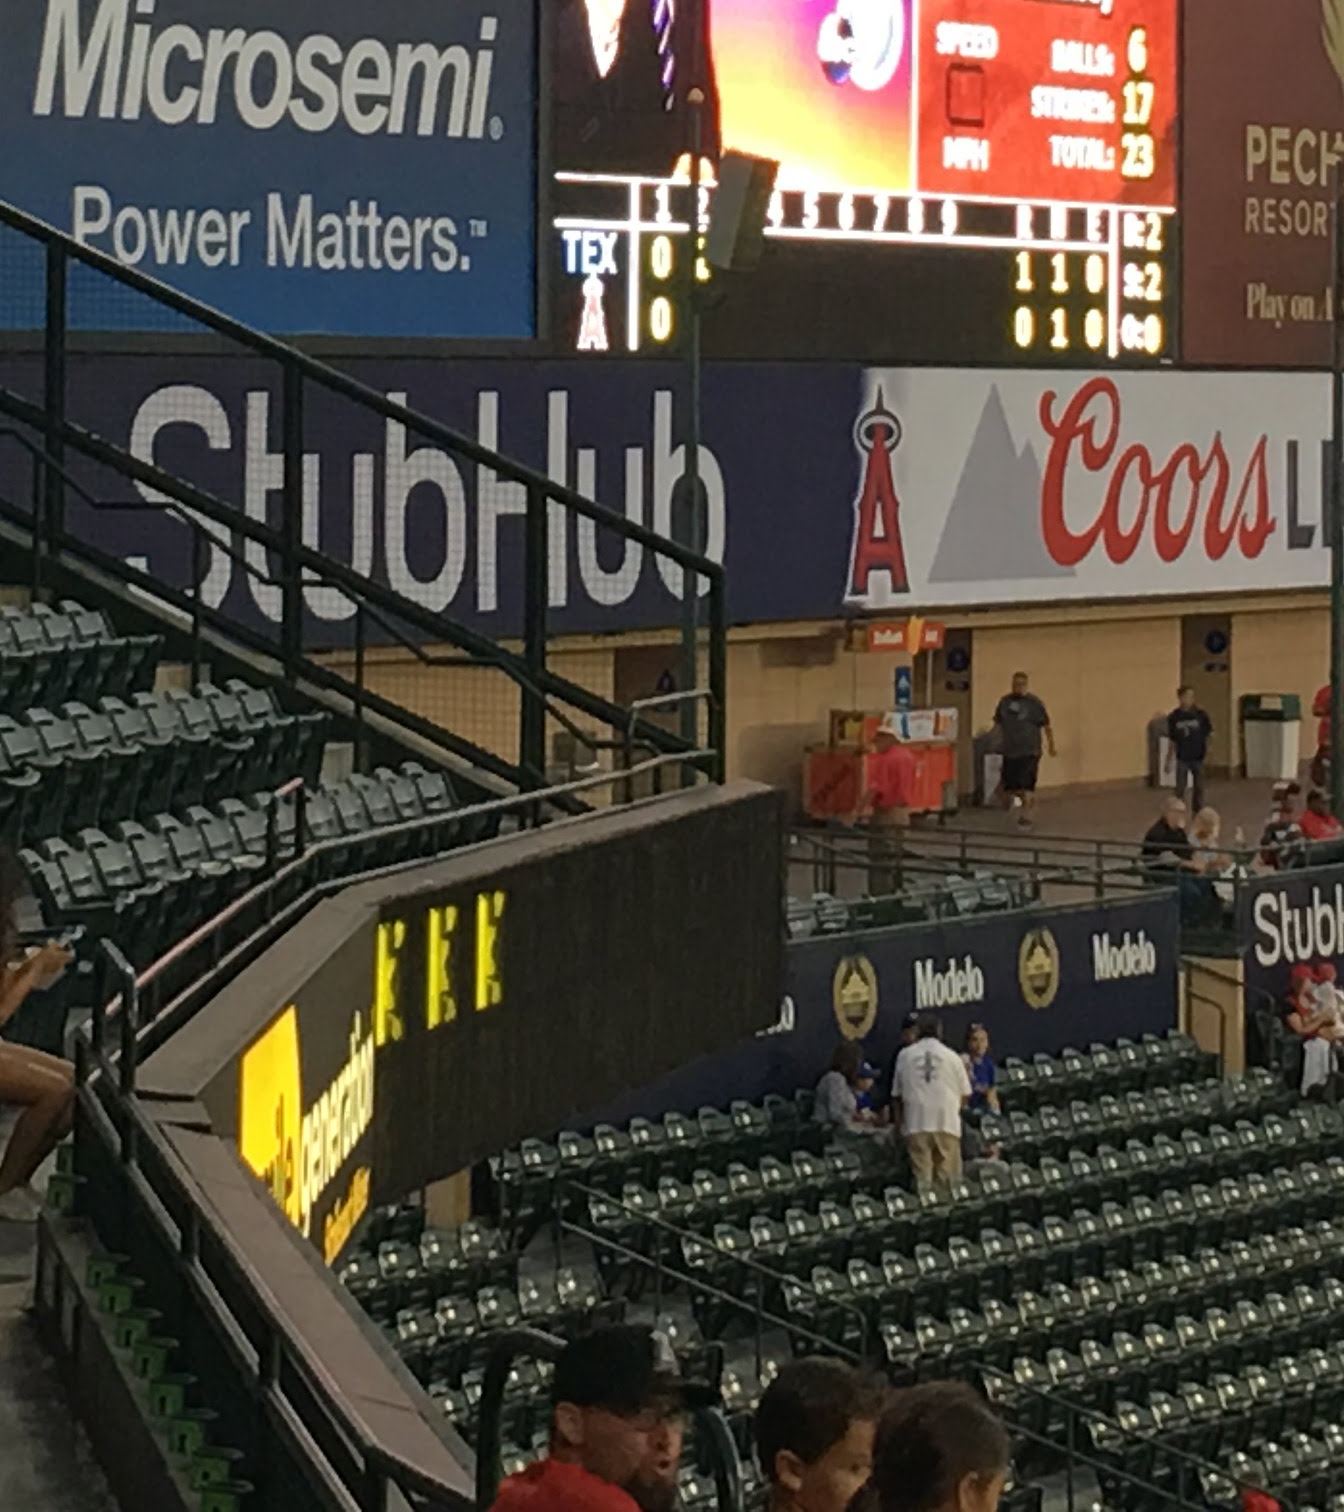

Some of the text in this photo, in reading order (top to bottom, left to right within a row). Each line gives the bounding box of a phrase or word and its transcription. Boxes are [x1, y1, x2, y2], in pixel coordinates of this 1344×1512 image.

[935, 21, 999, 59] SPEED
[1126, 28, 1147, 73] 6
[1121, 81, 1155, 125] 17
[943, 136, 990, 171] MPH
[1048, 133, 1154, 178] TOTAL: 23
[72, 185, 251, 266] Power
[1245, 197, 1336, 238] RESOR
[561, 230, 618, 275] TEX
[651, 235, 672, 279] 0
[1016, 250, 1033, 291] 1
[1050, 252, 1069, 293] 1
[1085, 253, 1104, 294] 0
[650, 297, 671, 341] 0
[1015, 306, 1033, 348] 0
[1050, 307, 1069, 349] 1
[1084, 308, 1104, 349] 0
[1245, 281, 1288, 329] Play
[1290, 294, 1315, 321] on
[1039, 376, 1277, 567] Coors
[126, 384, 728, 625] StubHub
[1092, 929, 1156, 982] Modelo
[913, 954, 986, 1010] Modelo
